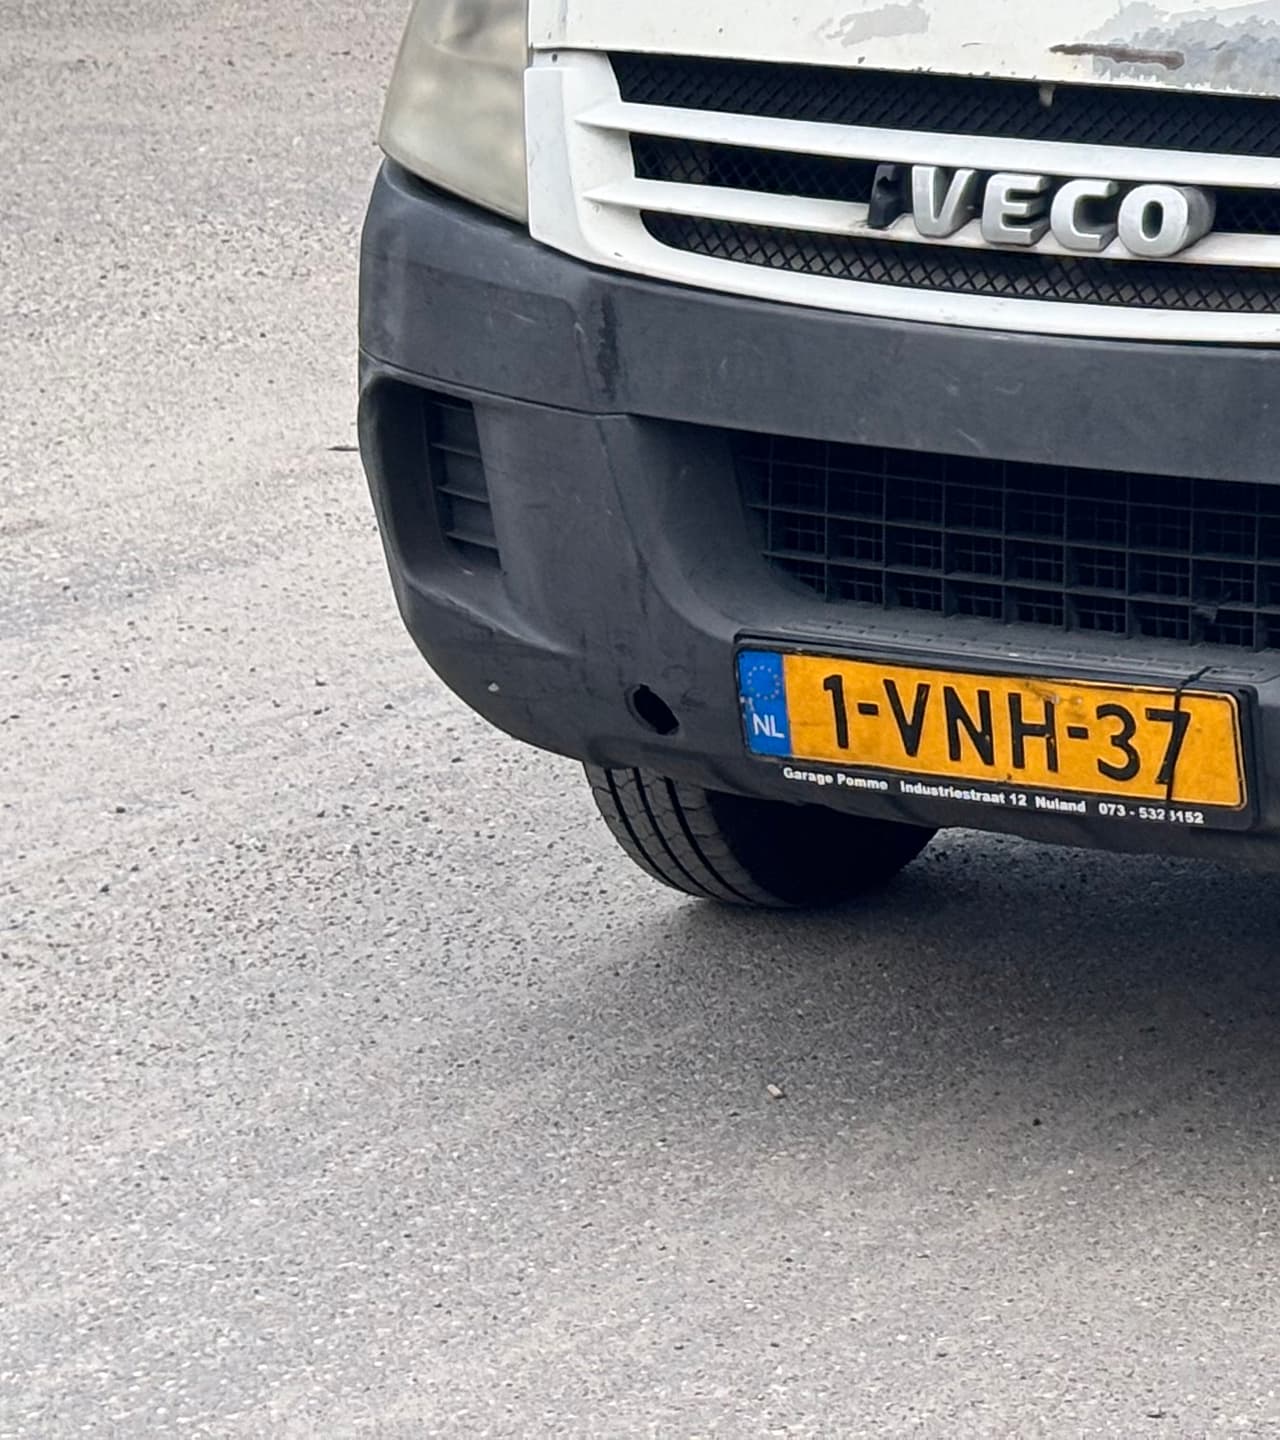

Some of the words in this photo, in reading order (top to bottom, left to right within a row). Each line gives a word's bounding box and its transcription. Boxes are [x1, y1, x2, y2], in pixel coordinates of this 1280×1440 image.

[752, 712, 785, 739] NL
[822, 673, 1192, 786] 1-VNH-37
[783, 767, 834, 786] Garage
[900, 780, 1006, 805] Industriestraat
[1009, 792, 1027, 807] 12
[1035, 796, 1086, 813] Nuland
[1098, 802, 1126, 818] 073
[1139, 807, 1166, 821] 532
